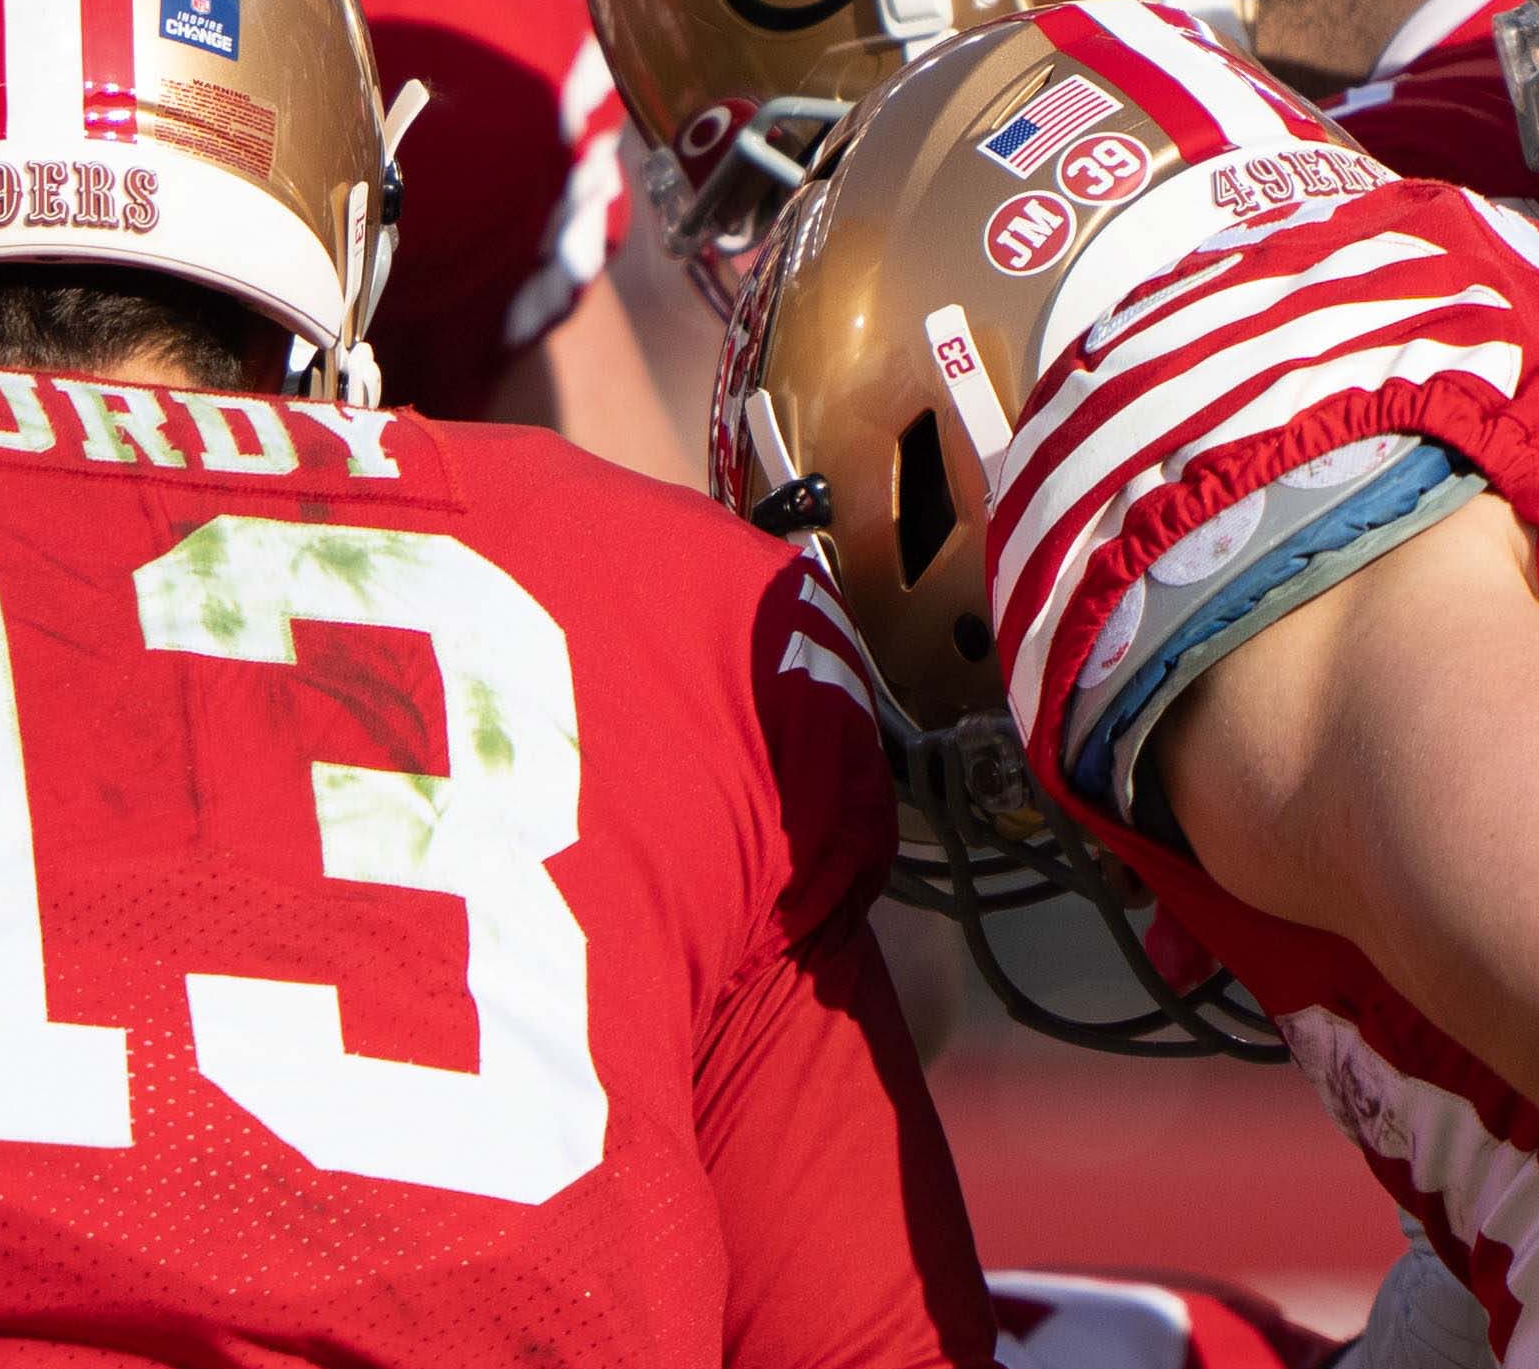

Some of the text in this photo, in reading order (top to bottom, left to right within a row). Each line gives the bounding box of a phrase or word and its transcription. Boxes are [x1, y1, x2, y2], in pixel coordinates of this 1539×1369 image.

[177, 11, 223, 33] INSPIRE
[192, 78, 251, 101] WARNING
[1066, 139, 1135, 195] 39
[995, 199, 1062, 267] JM
[937, 336, 976, 380] 23
